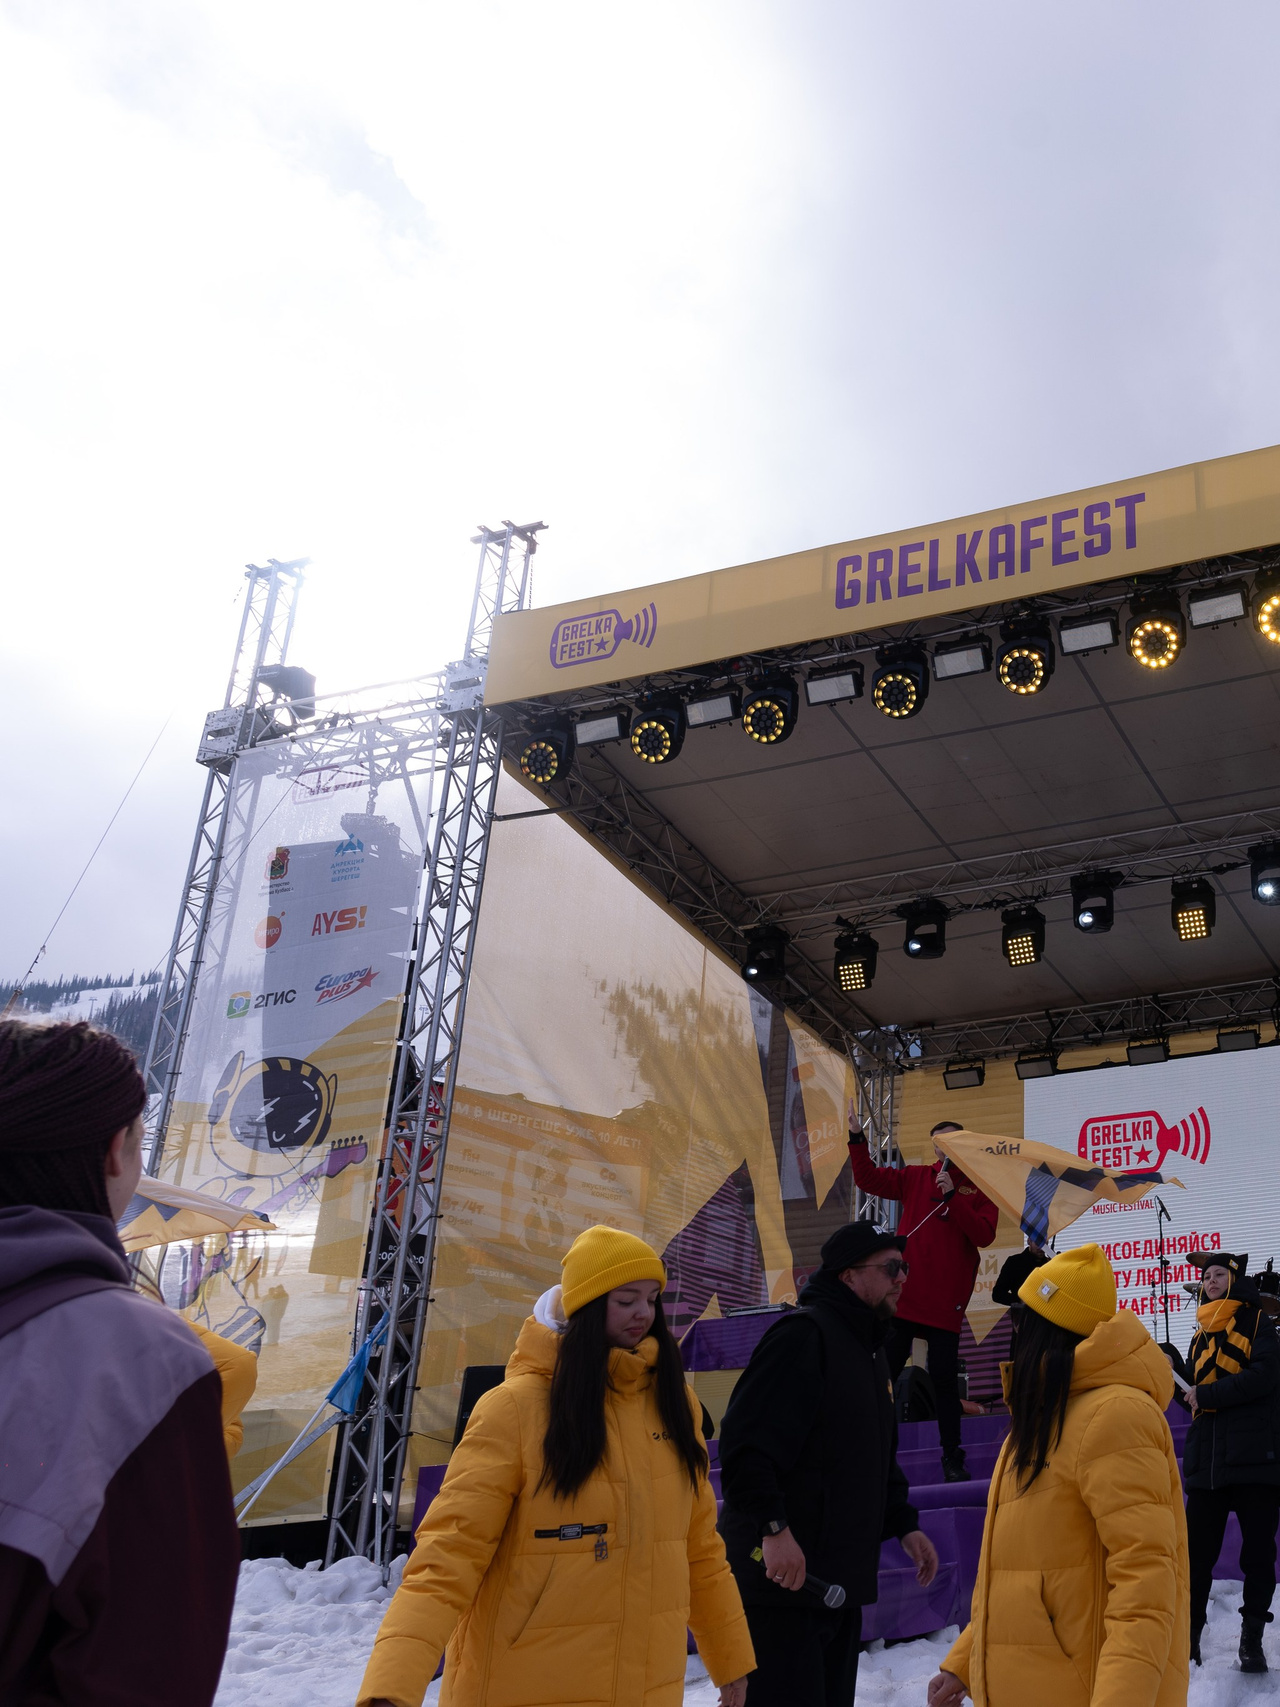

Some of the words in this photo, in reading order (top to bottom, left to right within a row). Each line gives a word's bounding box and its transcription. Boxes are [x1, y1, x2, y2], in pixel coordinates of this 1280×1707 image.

[835, 492, 1146, 610] GRELKAFEST
[562, 616, 612, 642] GRELKA
[560, 638, 595, 661] FEST
[330, 858, 365, 869] ДИРЕКЦИЯ
[332, 867, 361, 875] КУРОРТА
[331, 873, 361, 882] ШЕРЕГЕШ
[311, 905, 368, 936] AYS!
[254, 988, 297, 1009] 2ГИС
[474, 1105, 483, 1118] В
[488, 1108, 562, 1134] ШЕРЕГЕШЕ
[566, 1124, 594, 1141] УЖЕ
[599, 1131, 610, 1144] 10
[613, 1135, 641, 1150] ЛЕТ!
[796, 1121, 838, 1149] Cola
[1091, 1120, 1153, 1146] GRELKA
[1091, 1146, 1133, 1169] FEST
[444, 1164, 496, 1178] квартирник
[581, 1181, 633, 1196] акустический
[590, 1190, 623, 1201] концерт
[1092, 1202, 1118, 1215] MUSIC
[1119, 1199, 1155, 1213] FESTIVAL
[1101, 1231, 1221, 1262] ИСОЕДИНЯЙСЯ
[1114, 1269, 1132, 1288] ТУ
[1135, 1264, 1203, 1287] ЛЮБИТЕ
[1119, 1294, 1182, 1316] KAFEST!
